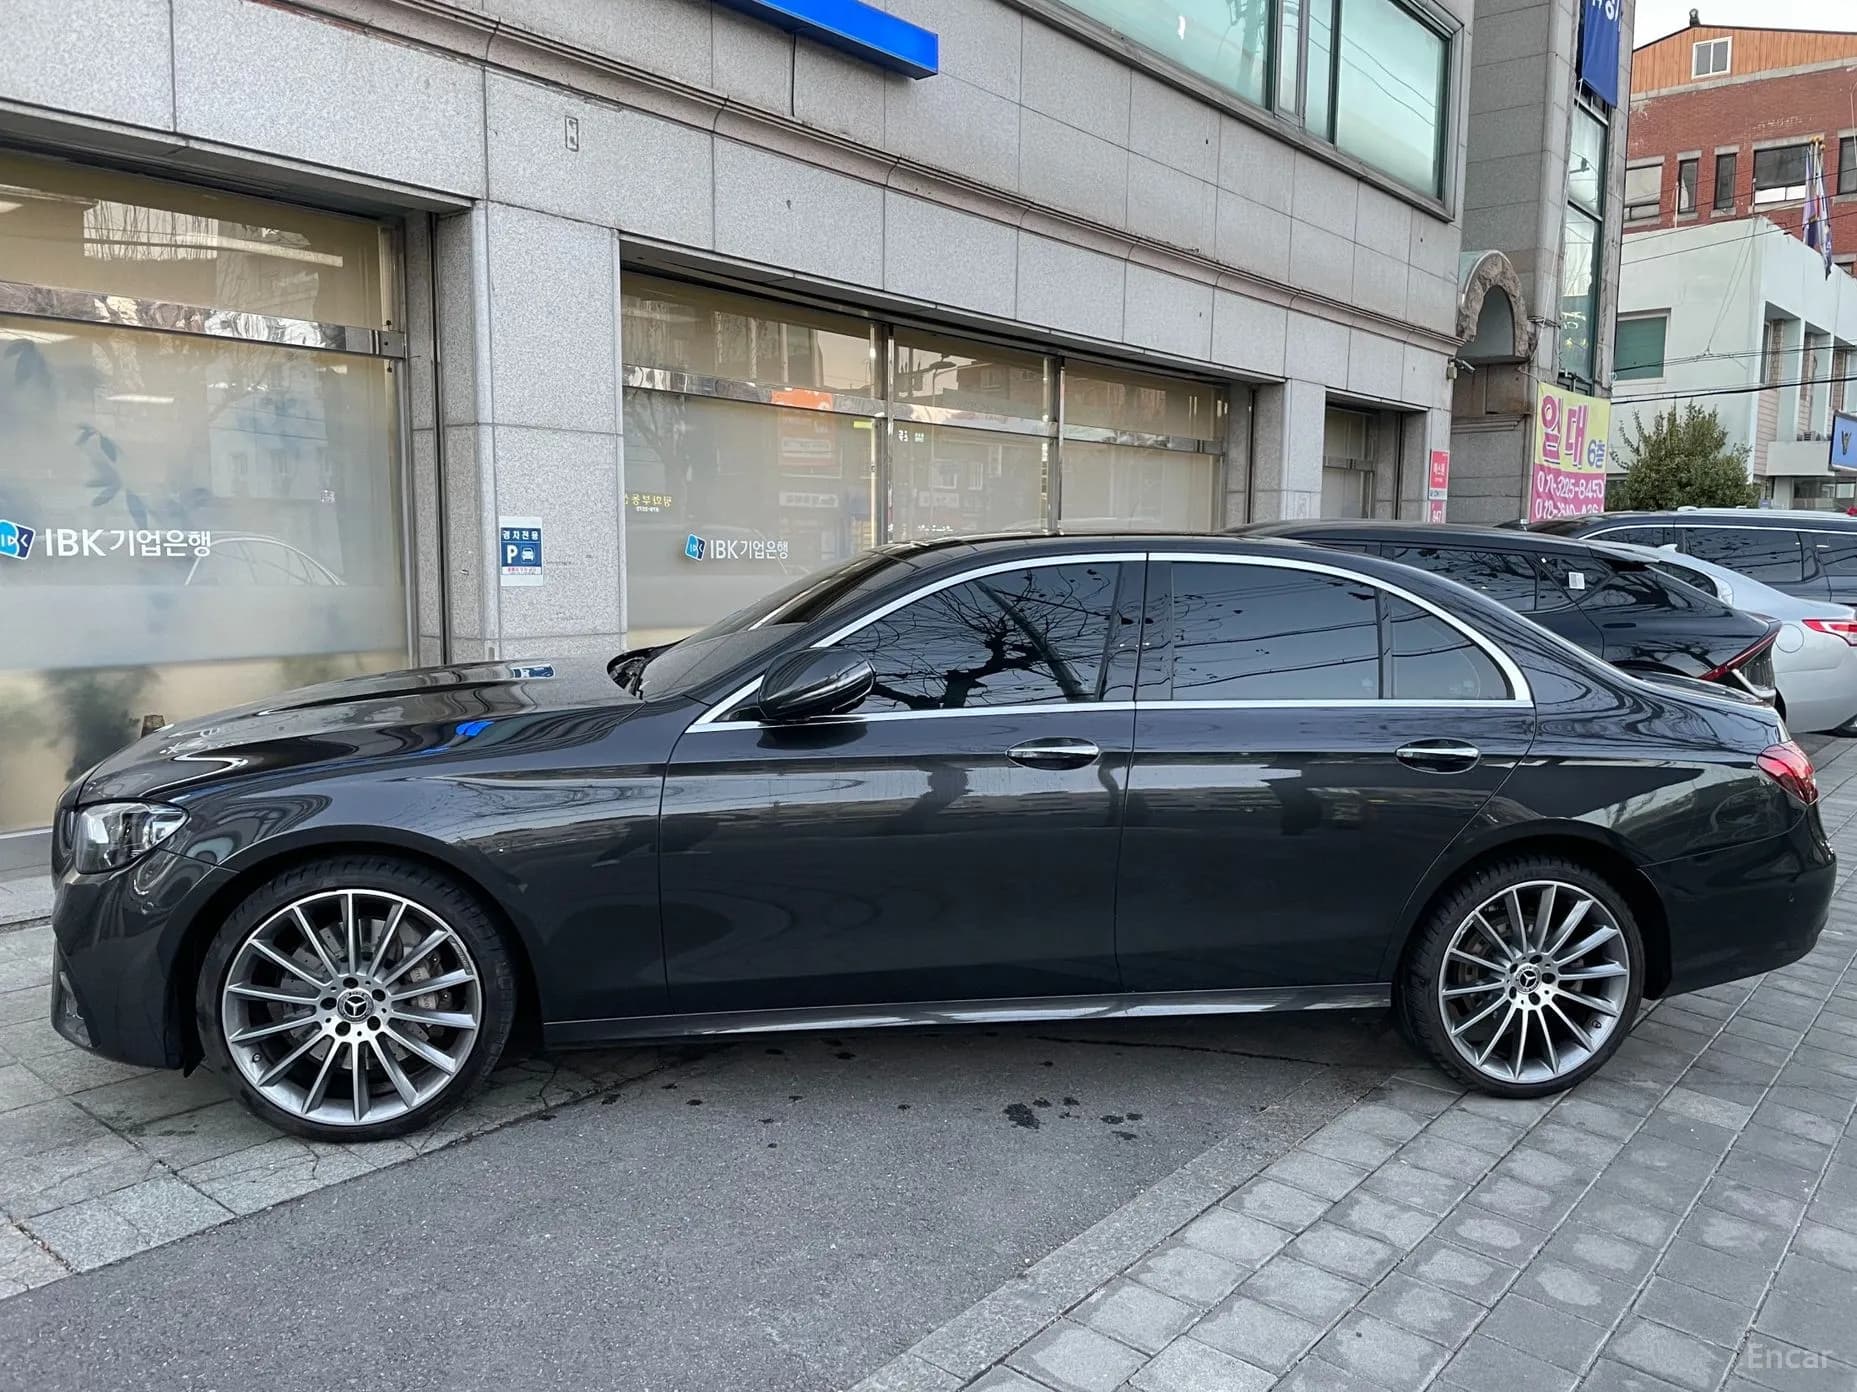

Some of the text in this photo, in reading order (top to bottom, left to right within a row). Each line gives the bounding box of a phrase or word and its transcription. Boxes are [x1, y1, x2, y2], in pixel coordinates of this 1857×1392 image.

[45, 528, 211, 558] IBK기업은행
[710, 539, 789, 559] IBK기업은행
[506, 544, 518, 564] P
